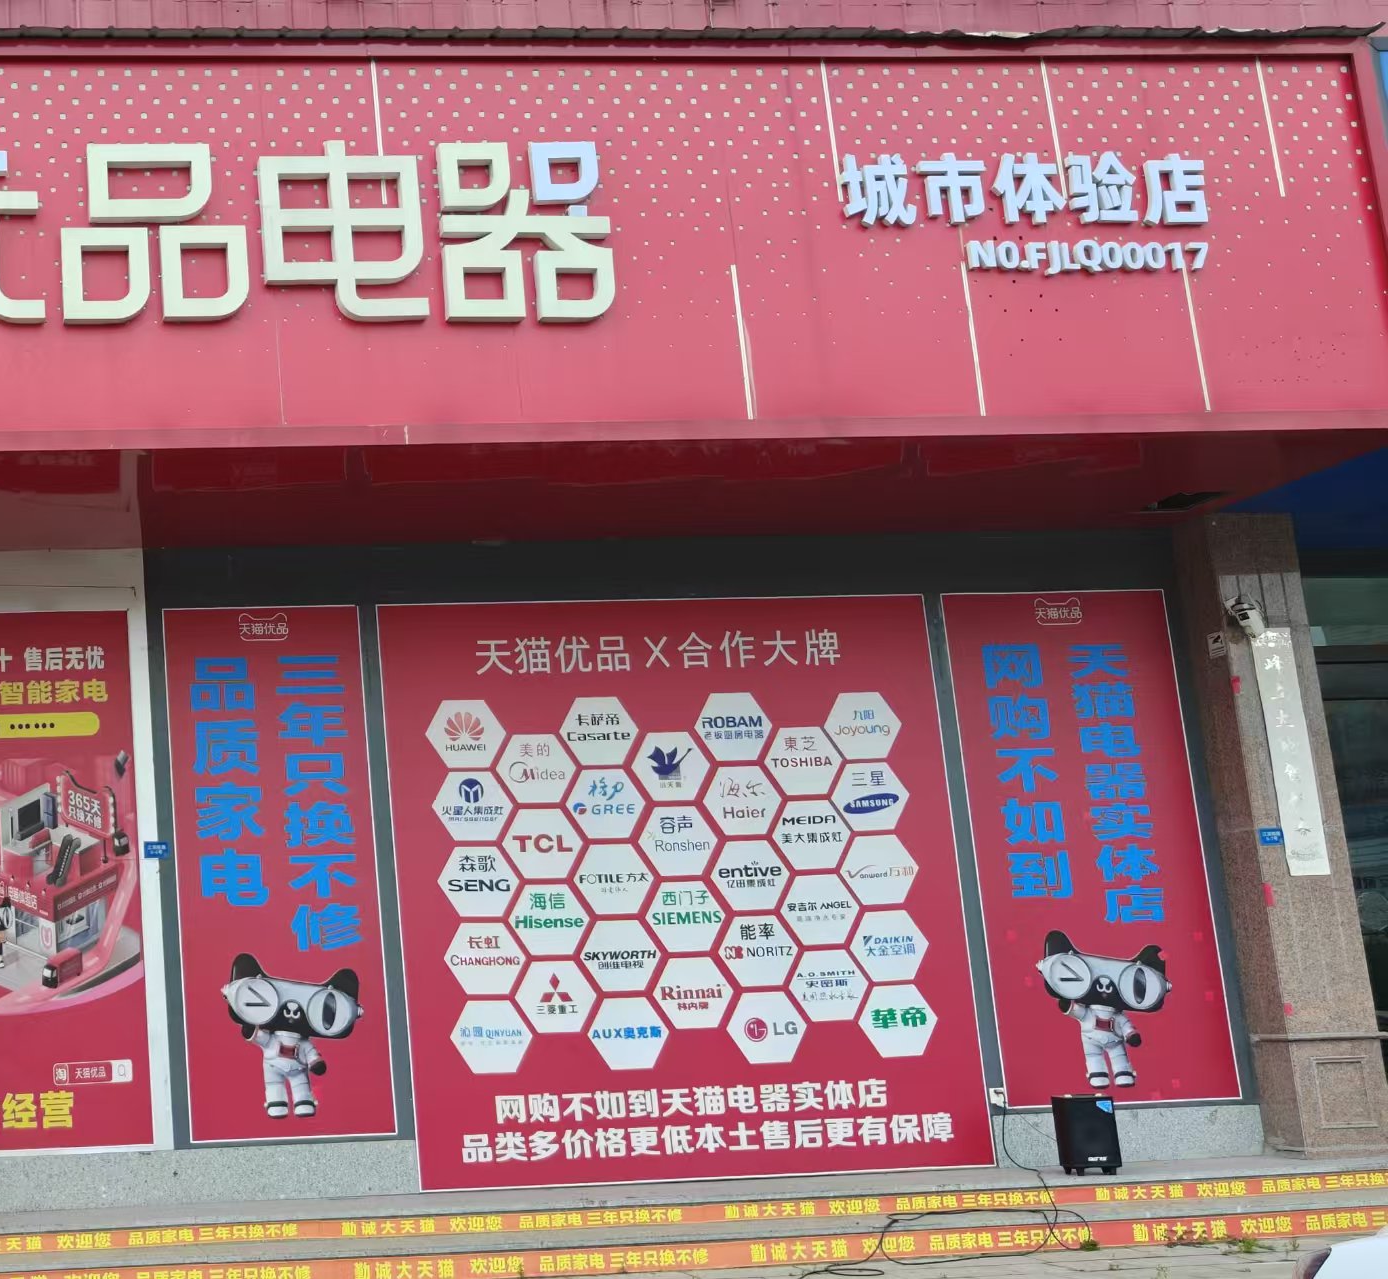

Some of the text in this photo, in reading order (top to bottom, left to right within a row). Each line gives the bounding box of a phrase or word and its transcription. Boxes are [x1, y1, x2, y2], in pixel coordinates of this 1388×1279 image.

[839, 151, 1210, 228] 城市体验店
[1034, 605, 1083, 621] 天猫优品
[239, 621, 289, 636] 天猫优品
[24, 646, 105, 673] 售后无忧
[475, 635, 632, 676] 天猫优品
[702, 716, 763, 729] ROBAM
[852, 710, 875, 721] 九阳
[567, 731, 631, 742] Casarte
[834, 724, 891, 737] Joyoung
[445, 743, 486, 752] HUAWEI
[519, 743, 550, 757] 美的
[771, 756, 833, 769] TOSHIBA
[851, 770, 887, 787] 三星
[981, 642, 1075, 900] 网购不如到
[189, 656, 269, 907] 品质家电
[1066, 643, 1165, 924] 天猫电器实体店
[67, 789, 101, 816] 365天
[275, 655, 364, 952] 三年只换不修
[591, 804, 636, 816] GREE
[850, 797, 895, 809] SAMSUNG
[441, 805, 504, 816] 火星人集成灶
[723, 805, 766, 820] Haier
[659, 815, 693, 835] 容声
[512, 834, 574, 854] TCL
[781, 831, 843, 844] 美大集成灶
[654, 840, 711, 853] Ronshen
[458, 855, 497, 873] 森歌
[718, 864, 782, 879] entive
[448, 878, 511, 892] SENG
[579, 872, 649, 884] FOTILE 方太
[529, 892, 566, 910] 海信
[662, 889, 710, 906] 西门子
[787, 900, 852, 912] 安吉尔 ANGEL
[514, 915, 585, 929] Hisense
[653, 910, 722, 925] SIEMENS
[740, 922, 775, 941] 能率
[467, 935, 501, 950] 长虹
[874, 935, 914, 945] DAIKIN
[583, 949, 657, 961] SKYWORTH
[746, 945, 794, 958] NORITZ
[865, 943, 916, 957] 大金空调
[597, 960, 645, 970] 创维电视
[660, 983, 724, 1001] Rinnai
[536, 1004, 579, 1015] 三菱重工
[485, 1028, 523, 1039] QINYUAN
[772, 1020, 799, 1036] LG
[74, 1066, 106, 1080] 天猫优品
[494, 1078, 889, 1124] 网购不如到天猫电器实体店
[461, 1111, 955, 1164] 品类多价格更低本土售后更有保障
[1196, 1179, 1247, 1197] 欢迎您
[1262, 1176, 1322, 1193] 品质家电
[1325, 1172, 1388, 1189] 三年只换
[828, 1198, 881, 1215] 欢迎您
[895, 1194, 958, 1211] 品质家电
[961, 1190, 1056, 1208] 三年只换不修
[449, 1215, 503, 1232] 欢迎您
[519, 1213, 583, 1229] 品质家电
[587, 1208, 684, 1225] 三年只换不修
[1241, 1215, 1292, 1234] 欢迎您
[1306, 1211, 1368, 1231] 品质家电
[56, 1232, 112, 1249] 欢迎您
[128, 1229, 194, 1246] 品质家电
[198, 1223, 299, 1240] 三年只换不修
[862, 1235, 916, 1254] 欢迎您
[929, 1232, 993, 1251] 品质家电
[470, 1256, 525, 1274] 欢迎您
[539, 1252, 606, 1271] 品质家电
[609, 1248, 709, 1267] 三年只换不修
